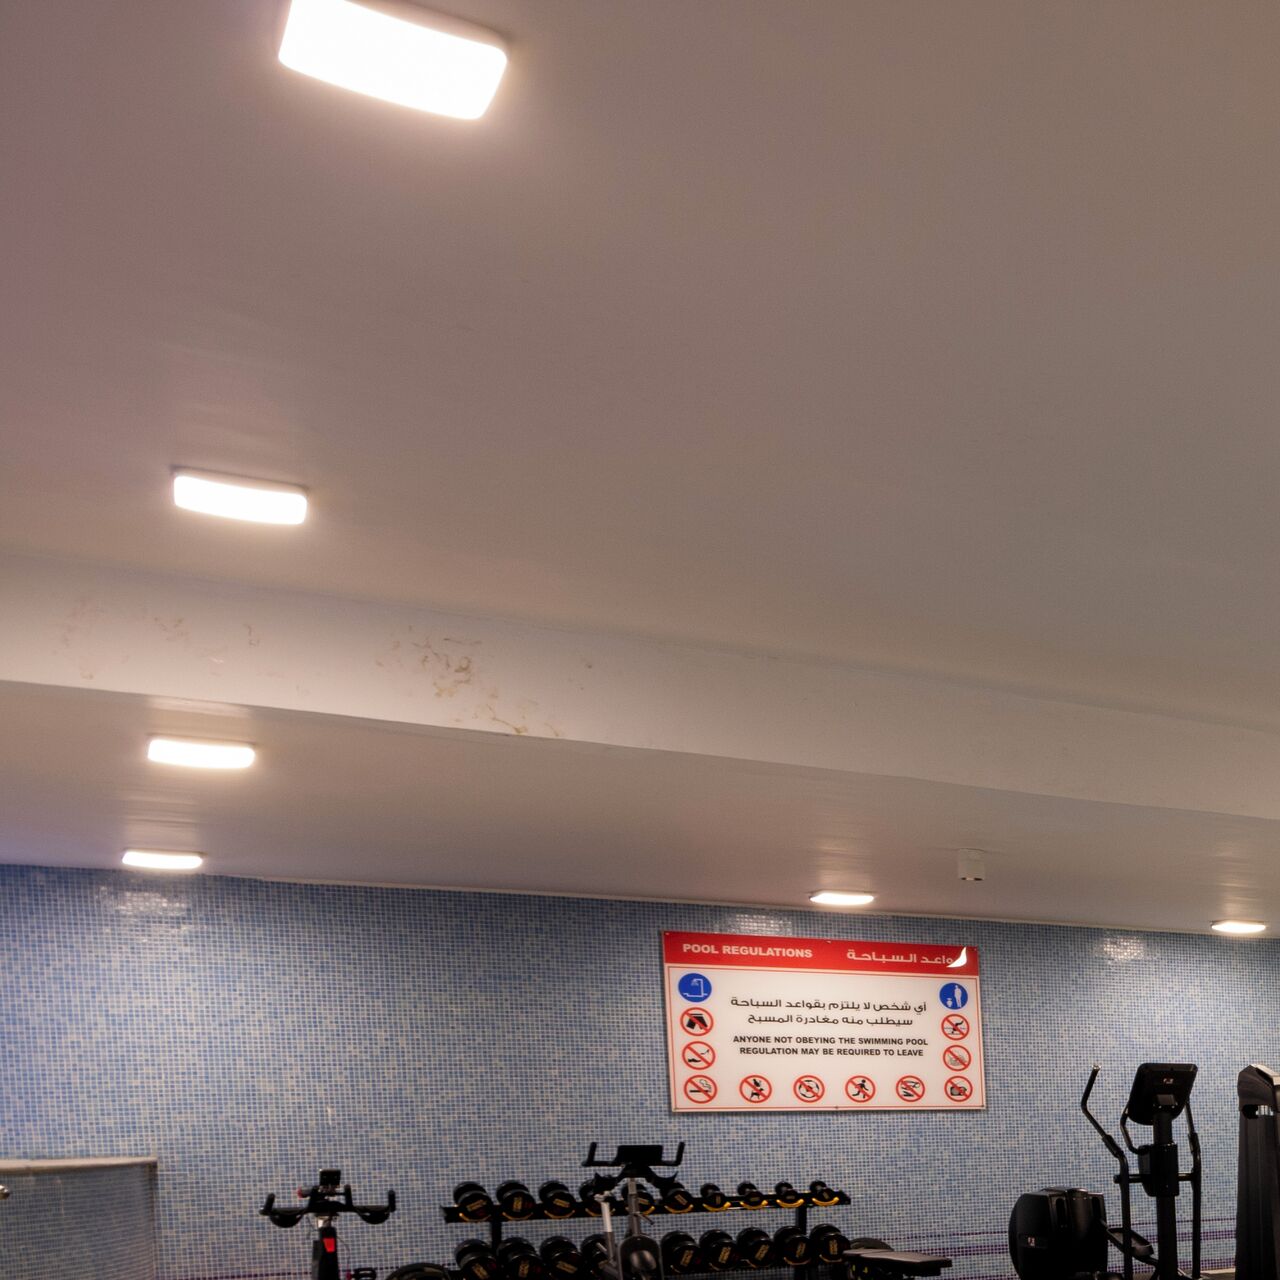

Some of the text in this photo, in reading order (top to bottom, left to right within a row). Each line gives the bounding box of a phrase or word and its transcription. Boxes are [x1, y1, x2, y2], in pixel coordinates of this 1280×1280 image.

[682, 943, 813, 958] POOL REGULATIONS
[846, 949, 960, 965] واعد السباحة
[730, 996, 927, 1015] أي شخص لا يلتزم بقواعد السباحة
[748, 1014, 913, 1027] سيطلب منه مغادرة المسبح
[733, 1035, 929, 1046] ANYONE NOT OBEYING THE SWIMMING POOL
[739, 1046, 924, 1057] REGULATION MAY BE REQUIRED TO LEAVE
